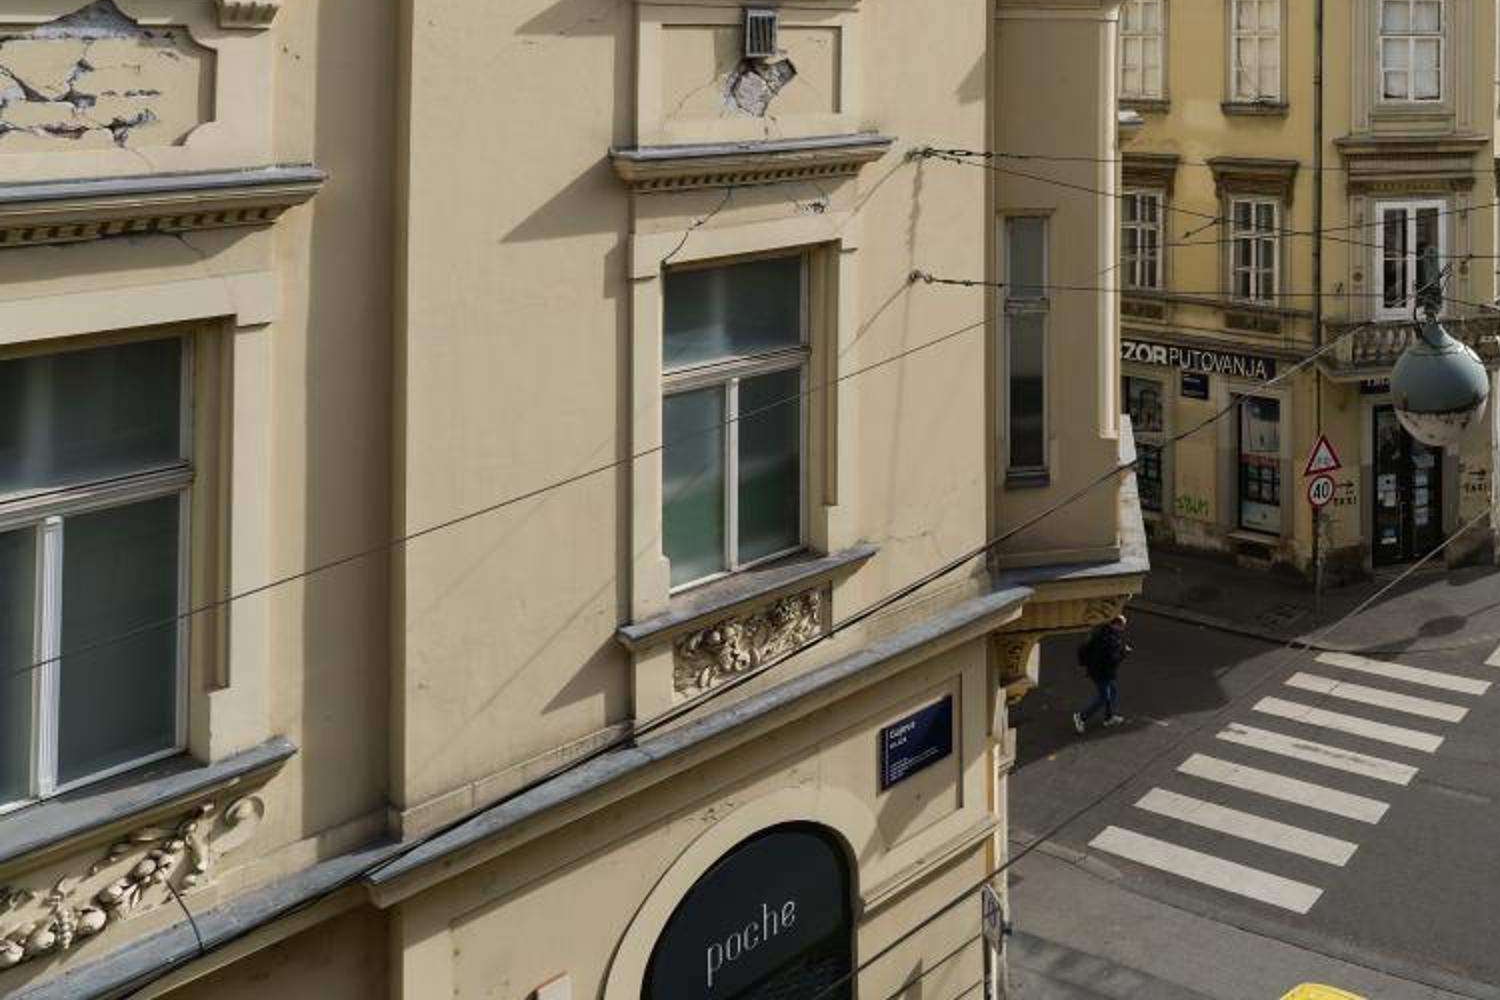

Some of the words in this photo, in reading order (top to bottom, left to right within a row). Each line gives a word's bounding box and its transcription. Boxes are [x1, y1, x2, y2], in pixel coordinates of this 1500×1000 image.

[1120, 341, 1168, 365] ZOR
[1169, 347, 1267, 380] PUTOVANJA
[1312, 481, 1329, 499] 40
[706, 901, 796, 989] poche
